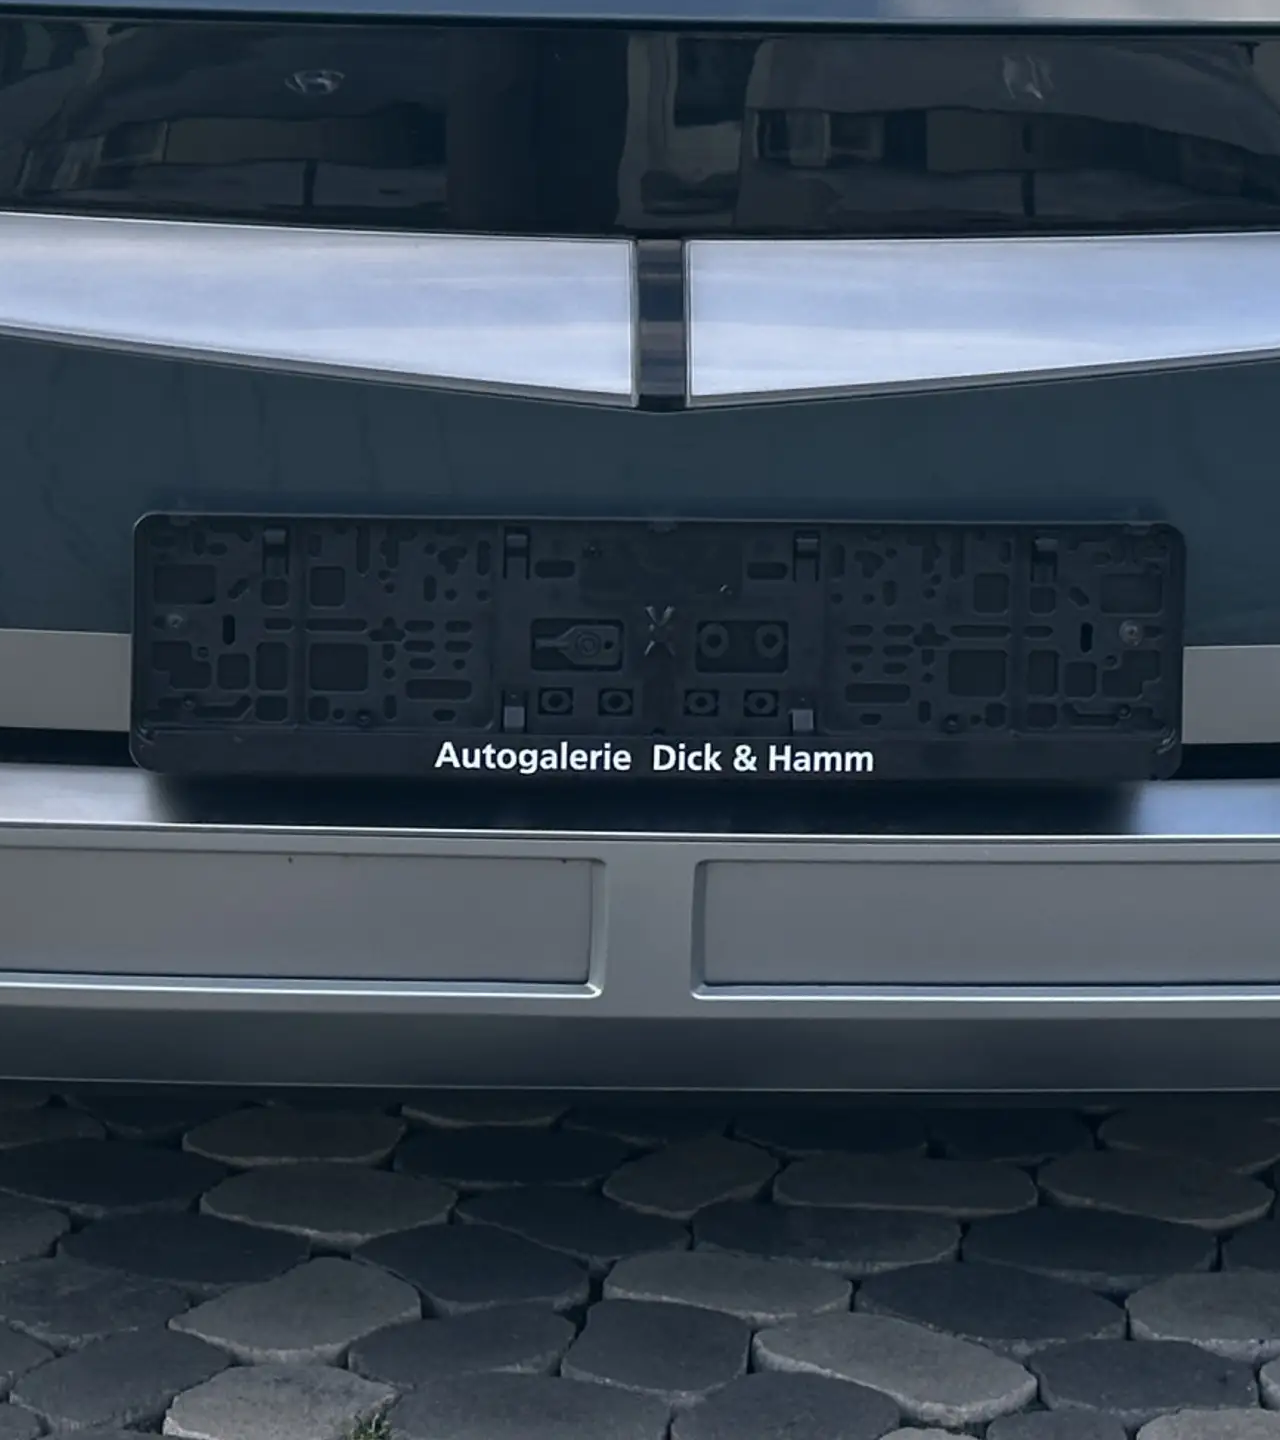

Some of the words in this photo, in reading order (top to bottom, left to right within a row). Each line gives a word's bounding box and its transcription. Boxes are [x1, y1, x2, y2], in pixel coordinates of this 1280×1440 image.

[434, 740, 633, 775] Autogalerie
[653, 741, 724, 772] Dick
[732, 743, 758, 773] &
[768, 743, 875, 773] Hamm
